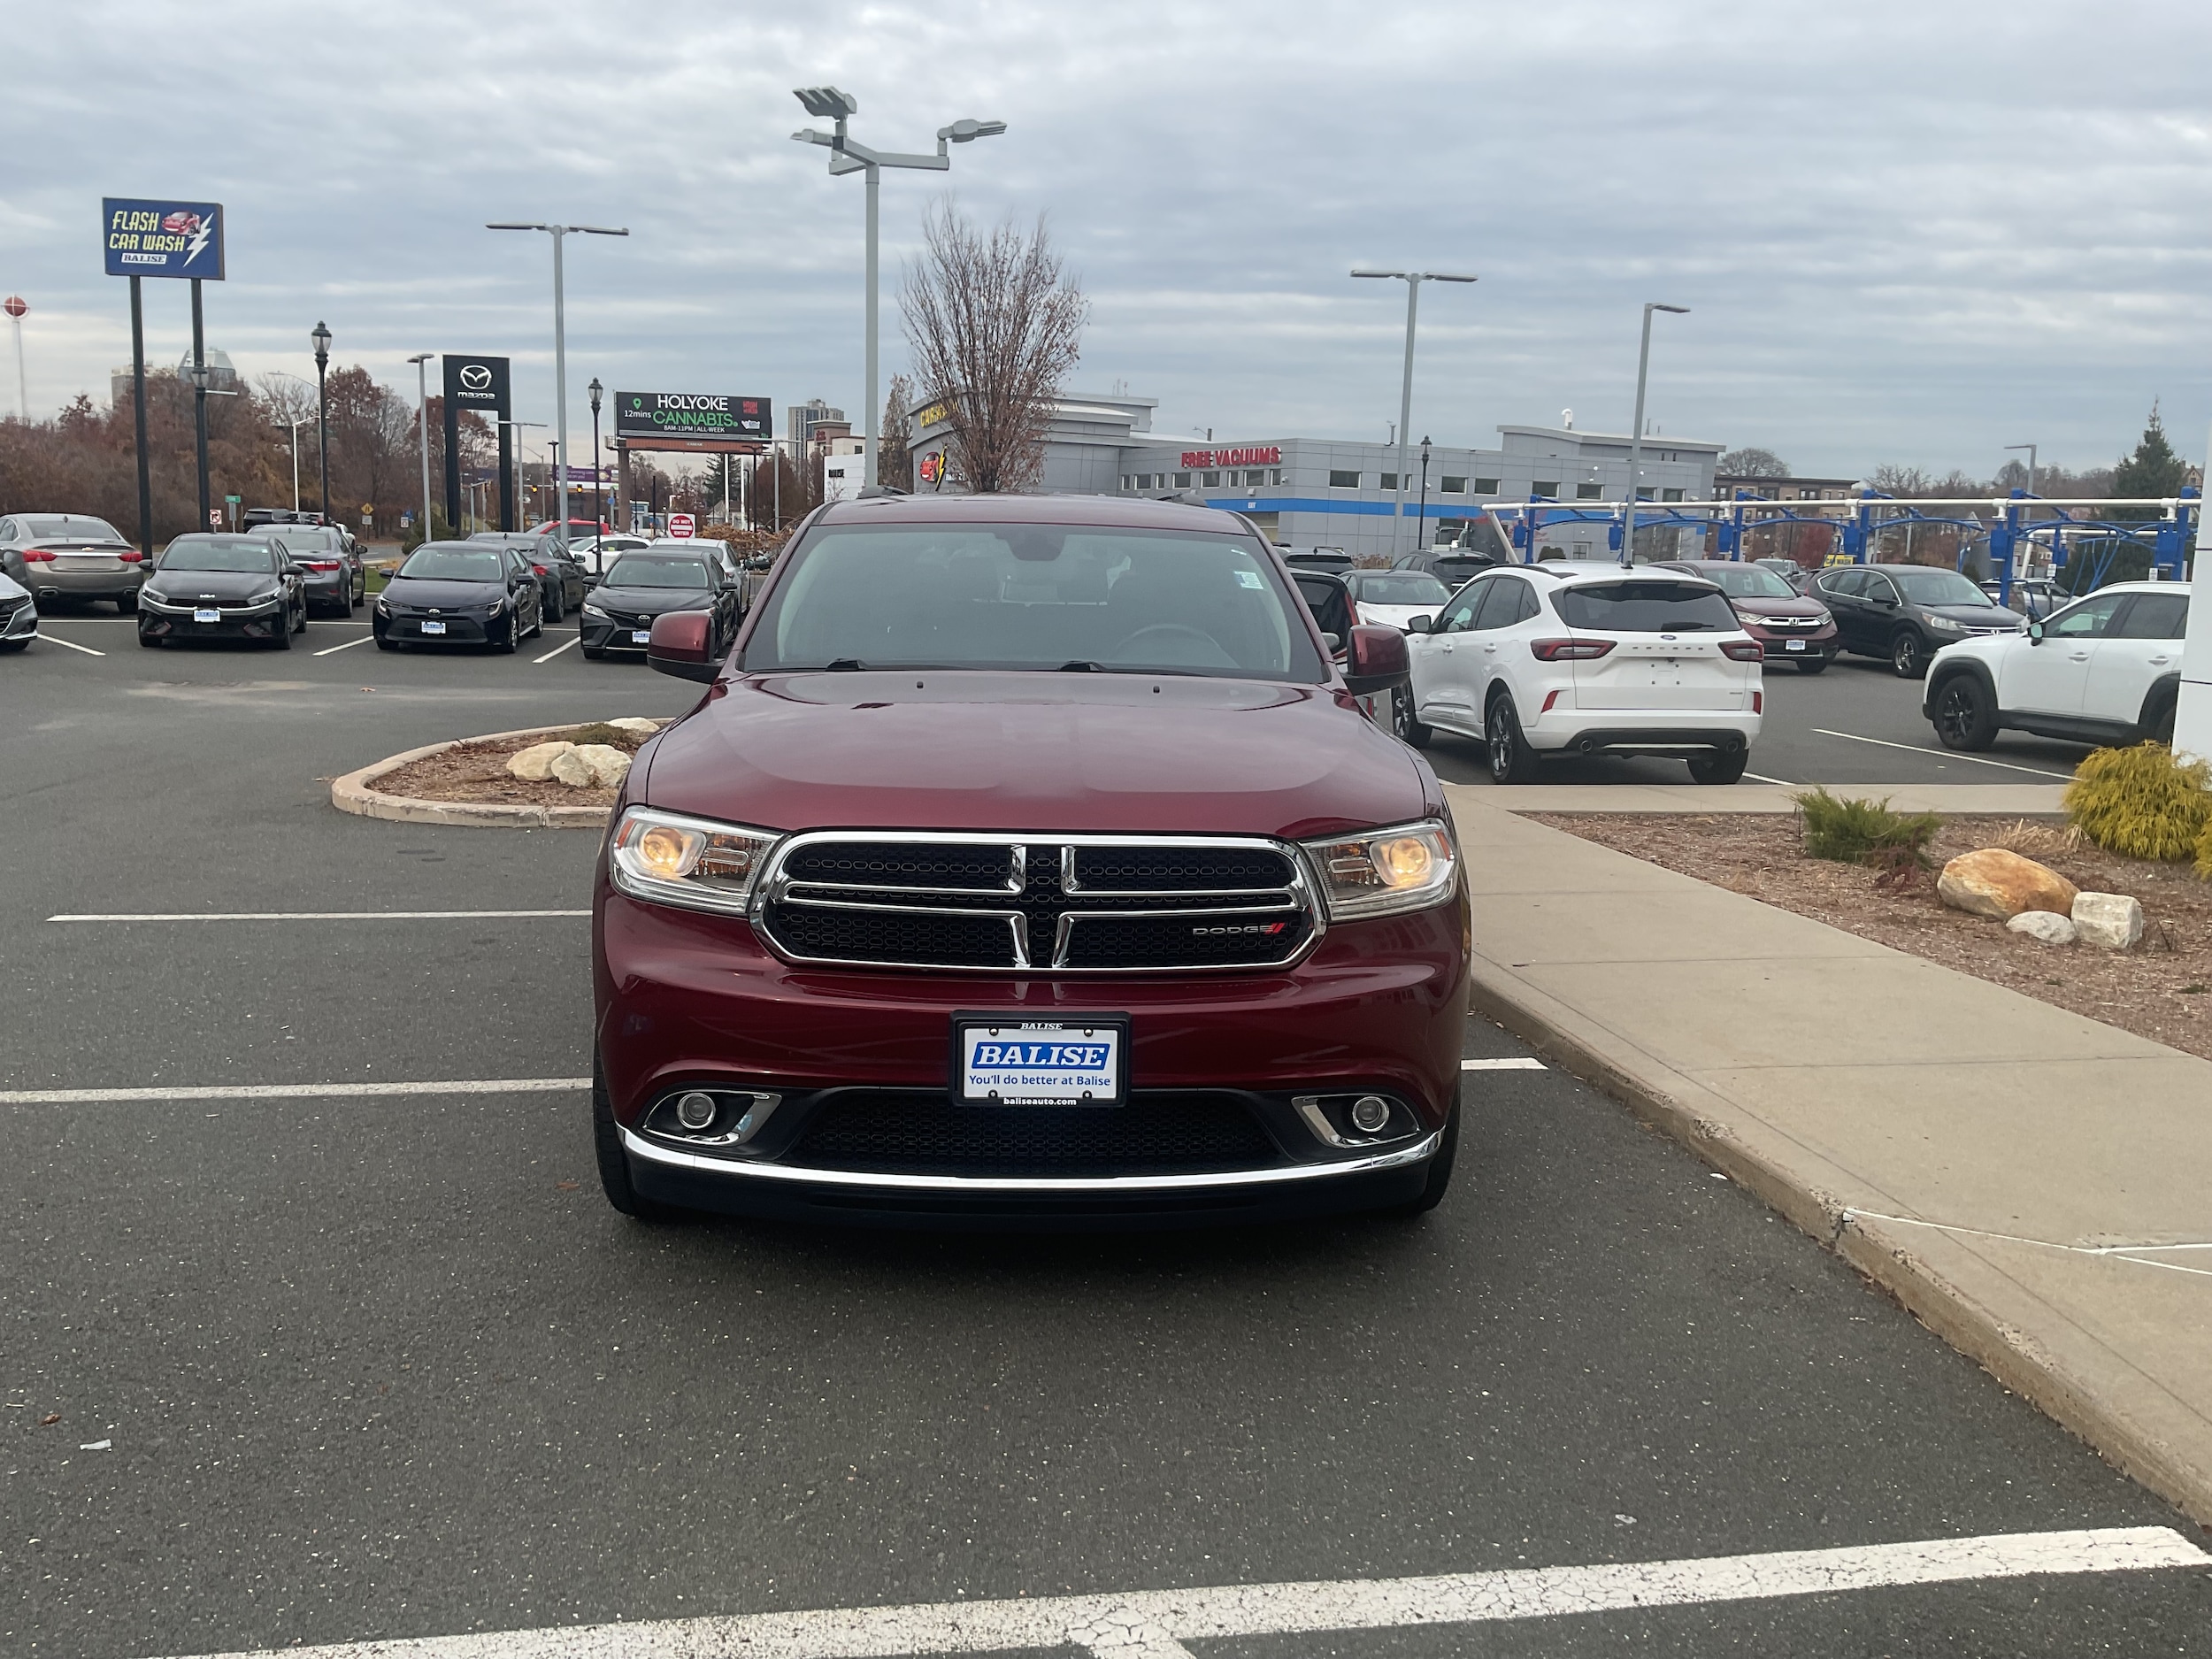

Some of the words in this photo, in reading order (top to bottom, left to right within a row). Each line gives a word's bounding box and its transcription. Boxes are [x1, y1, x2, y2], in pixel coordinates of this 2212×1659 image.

[112, 211, 159, 232] FLASH
[109, 233, 139, 250] CAR
[142, 234, 185, 252] WASH
[124, 254, 165, 264] BALISE
[657, 395, 728, 411] HOLYOKE
[624, 410, 651, 419] 12mins
[1181, 450, 1213, 468] FREE
[1215, 446, 1281, 467] VACUUMS
[1193, 925, 1274, 935] DODGE
[976, 1046, 1105, 1066] BALISE
[970, 1075, 1000, 1085] You'll
[1003, 1075, 1018, 1085] do
[1022, 1075, 1057, 1085] better
[1062, 1076, 1073, 1085] at
[1077, 1076, 1110, 1086] Balise
